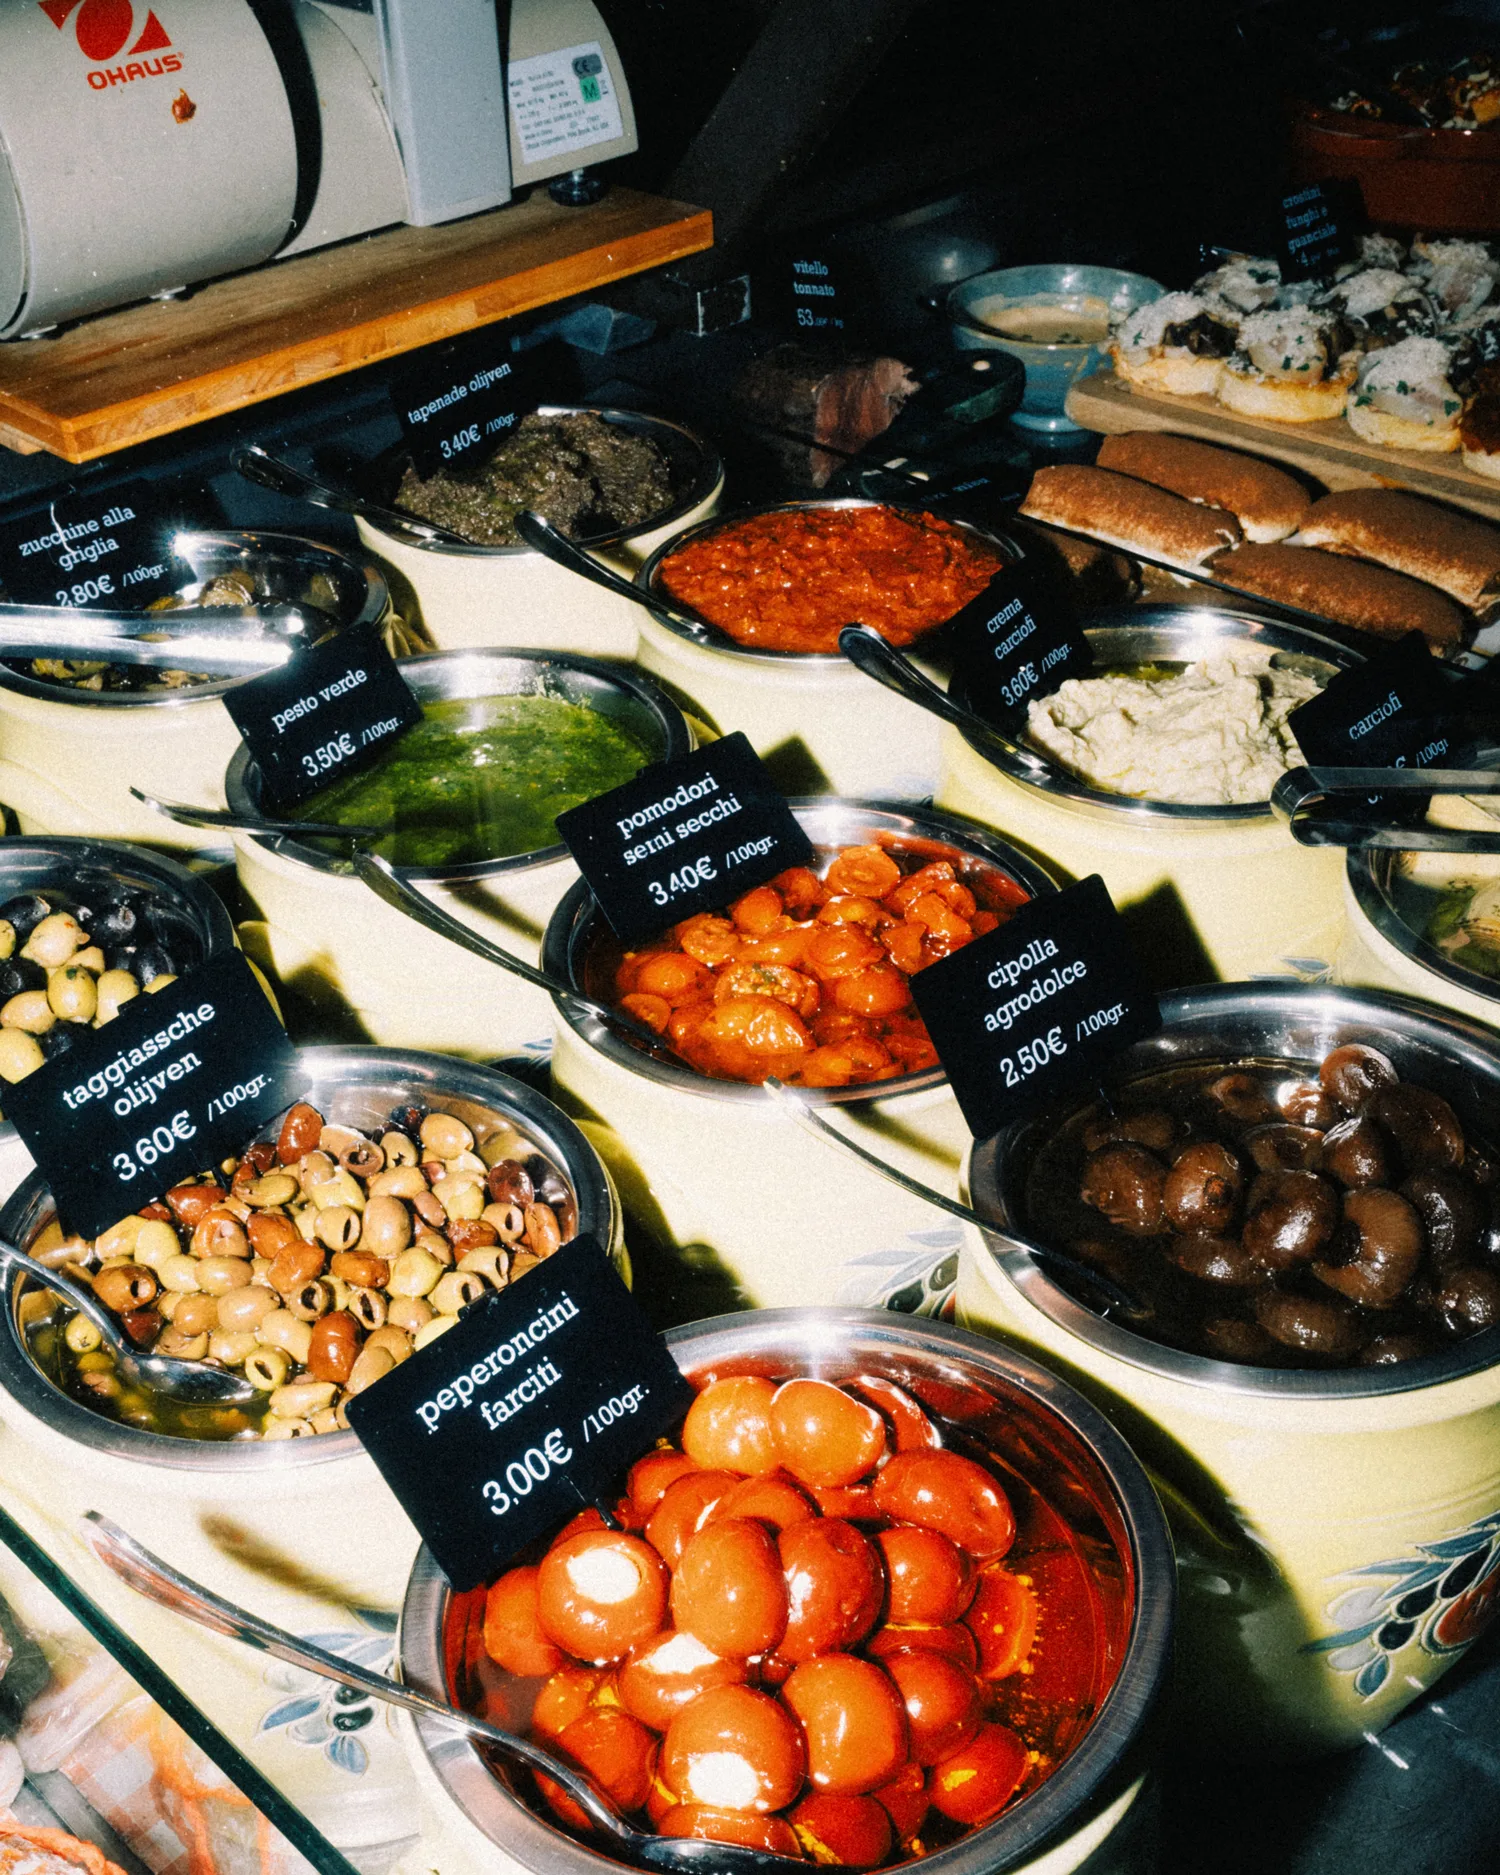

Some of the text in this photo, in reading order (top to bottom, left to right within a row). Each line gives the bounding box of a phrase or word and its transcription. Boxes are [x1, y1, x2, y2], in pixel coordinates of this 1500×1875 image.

[87, 54, 183, 90] OHAUS
[793, 260, 829, 276] vitello
[793, 281, 836, 297] tonnato
[407, 362, 512, 424] tapenade olijven
[485, 412, 519, 435] /100gr.
[19, 506, 136, 557] zucchine alla
[58, 537, 120, 571] griglia
[122, 563, 168, 587] /100gr.
[986, 597, 1024, 634] crema
[994, 613, 1038, 660] carciofi
[1041, 642, 1073, 674] /100gr.
[271, 669, 368, 734] pesto verde
[1349, 690, 1403, 740] carciofi
[302, 717, 403, 777] 3,50€ /100gr.
[616, 772, 719, 840] pomodori
[623, 793, 742, 866] semi secchi
[648, 835, 778, 905] 3,40€ /100gr.
[987, 938, 1059, 989] cipolla
[983, 960, 1087, 1032] agrodolce
[62, 1003, 216, 1110] taggiassche
[999, 1003, 1129, 1088] 2,50€ /100gr.
[113, 1052, 202, 1116] olijven
[112, 1074, 273, 1181] 3,60€ /100gr.
[416, 1290, 580, 1435] peperoncini
[480, 1356, 562, 1431] farciti
[482, 1384, 650, 1516] 3,00€ /100gr.
